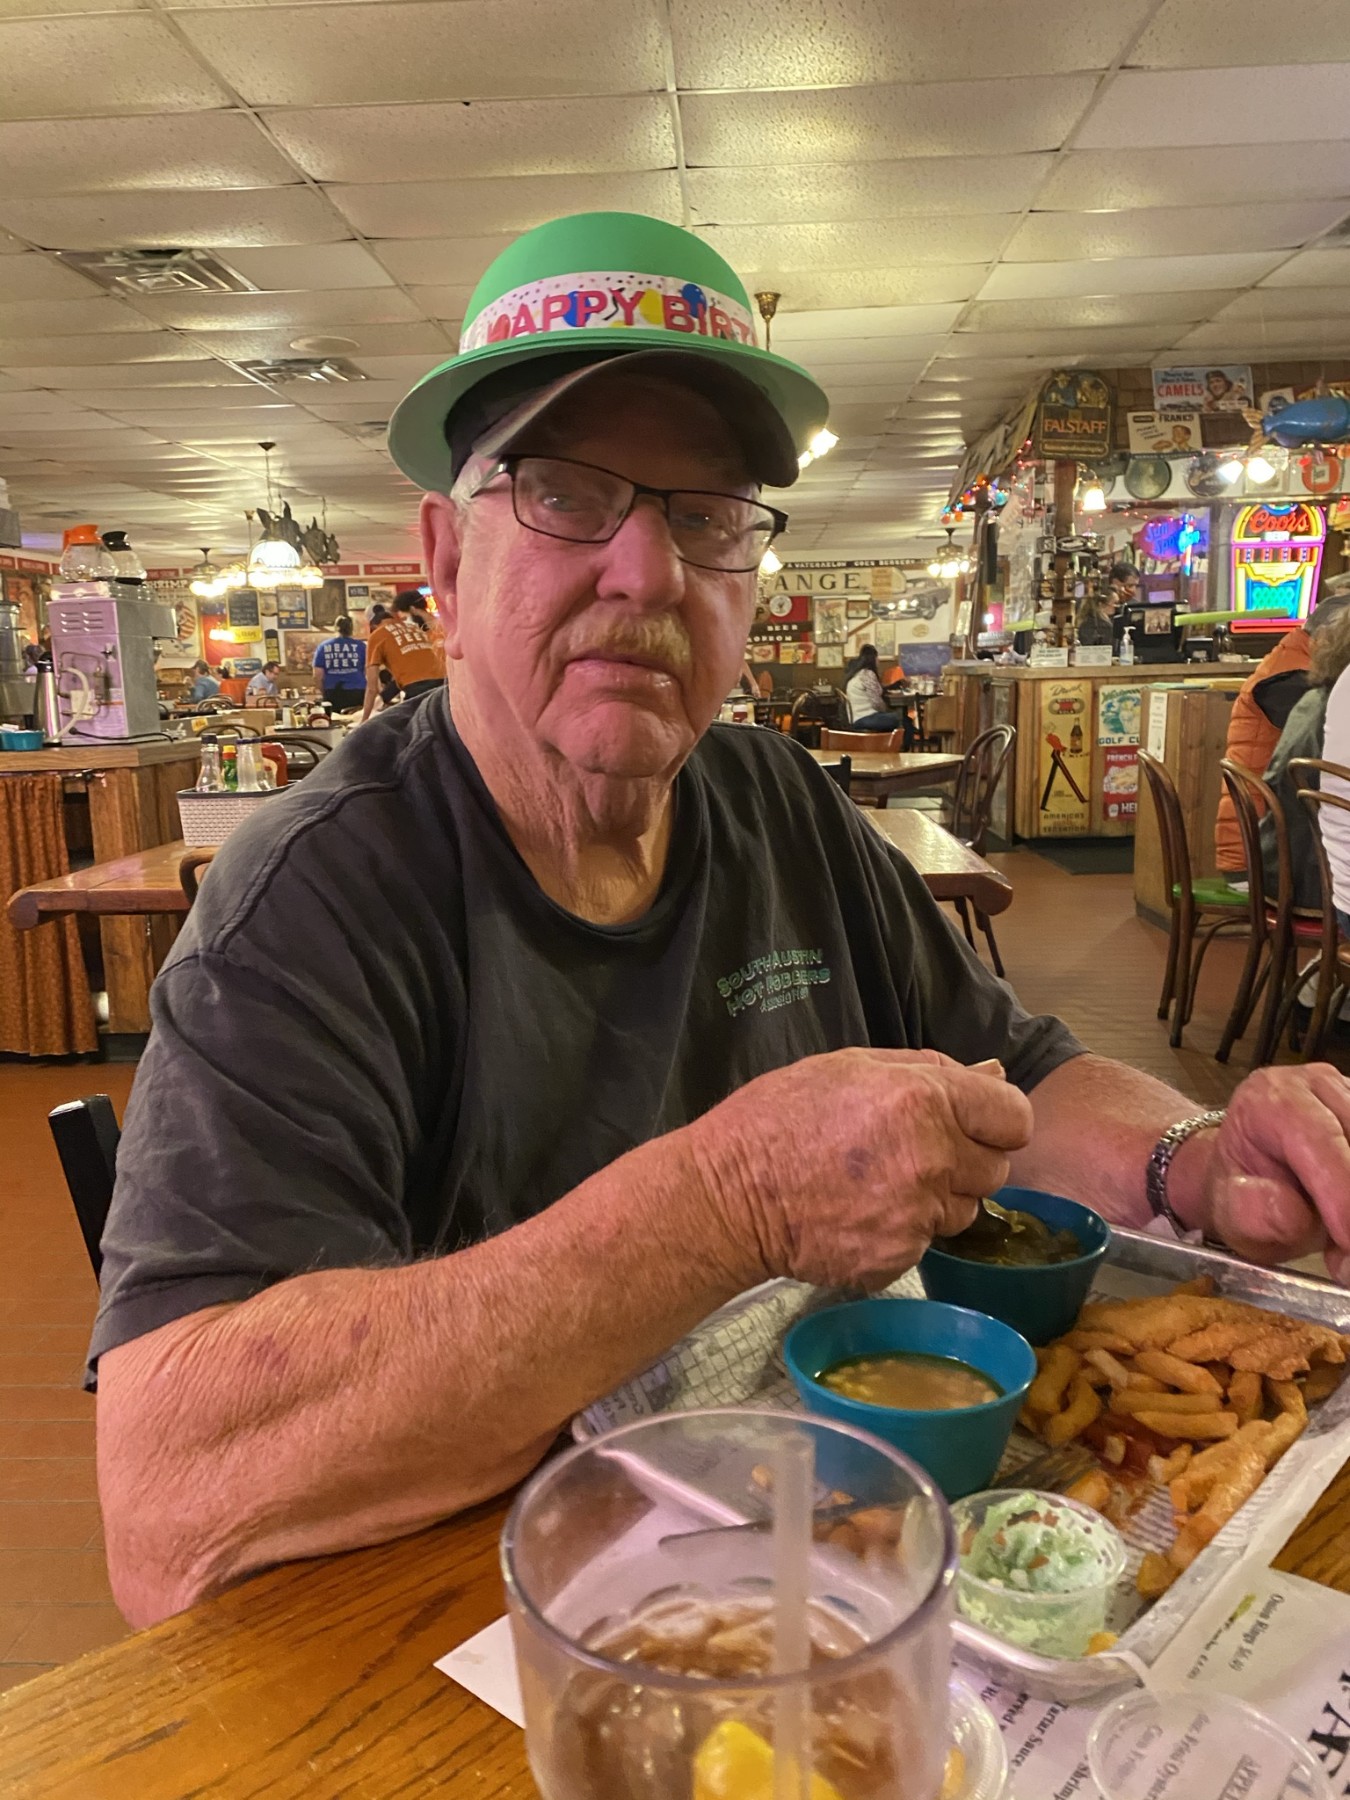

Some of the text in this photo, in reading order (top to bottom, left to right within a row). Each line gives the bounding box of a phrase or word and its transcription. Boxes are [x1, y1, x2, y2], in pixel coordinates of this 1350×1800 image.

[1157, 383, 1204, 397] CAMELS
[1043, 418, 1107, 434] FALSTAFF
[1249, 509, 1309, 533] Coors
[774, 573, 861, 592] ANGE
[767, 624, 798, 632] BEER
[323, 643, 358, 653] MEAT
[325, 659, 359, 669] FEET
[1099, 737, 1124, 745] GOLF
[726, 981, 764, 1017] HOT
[1002, 1692, 1030, 1725] erved
[1010, 1700, 1069, 1767] Tartar Sauce
